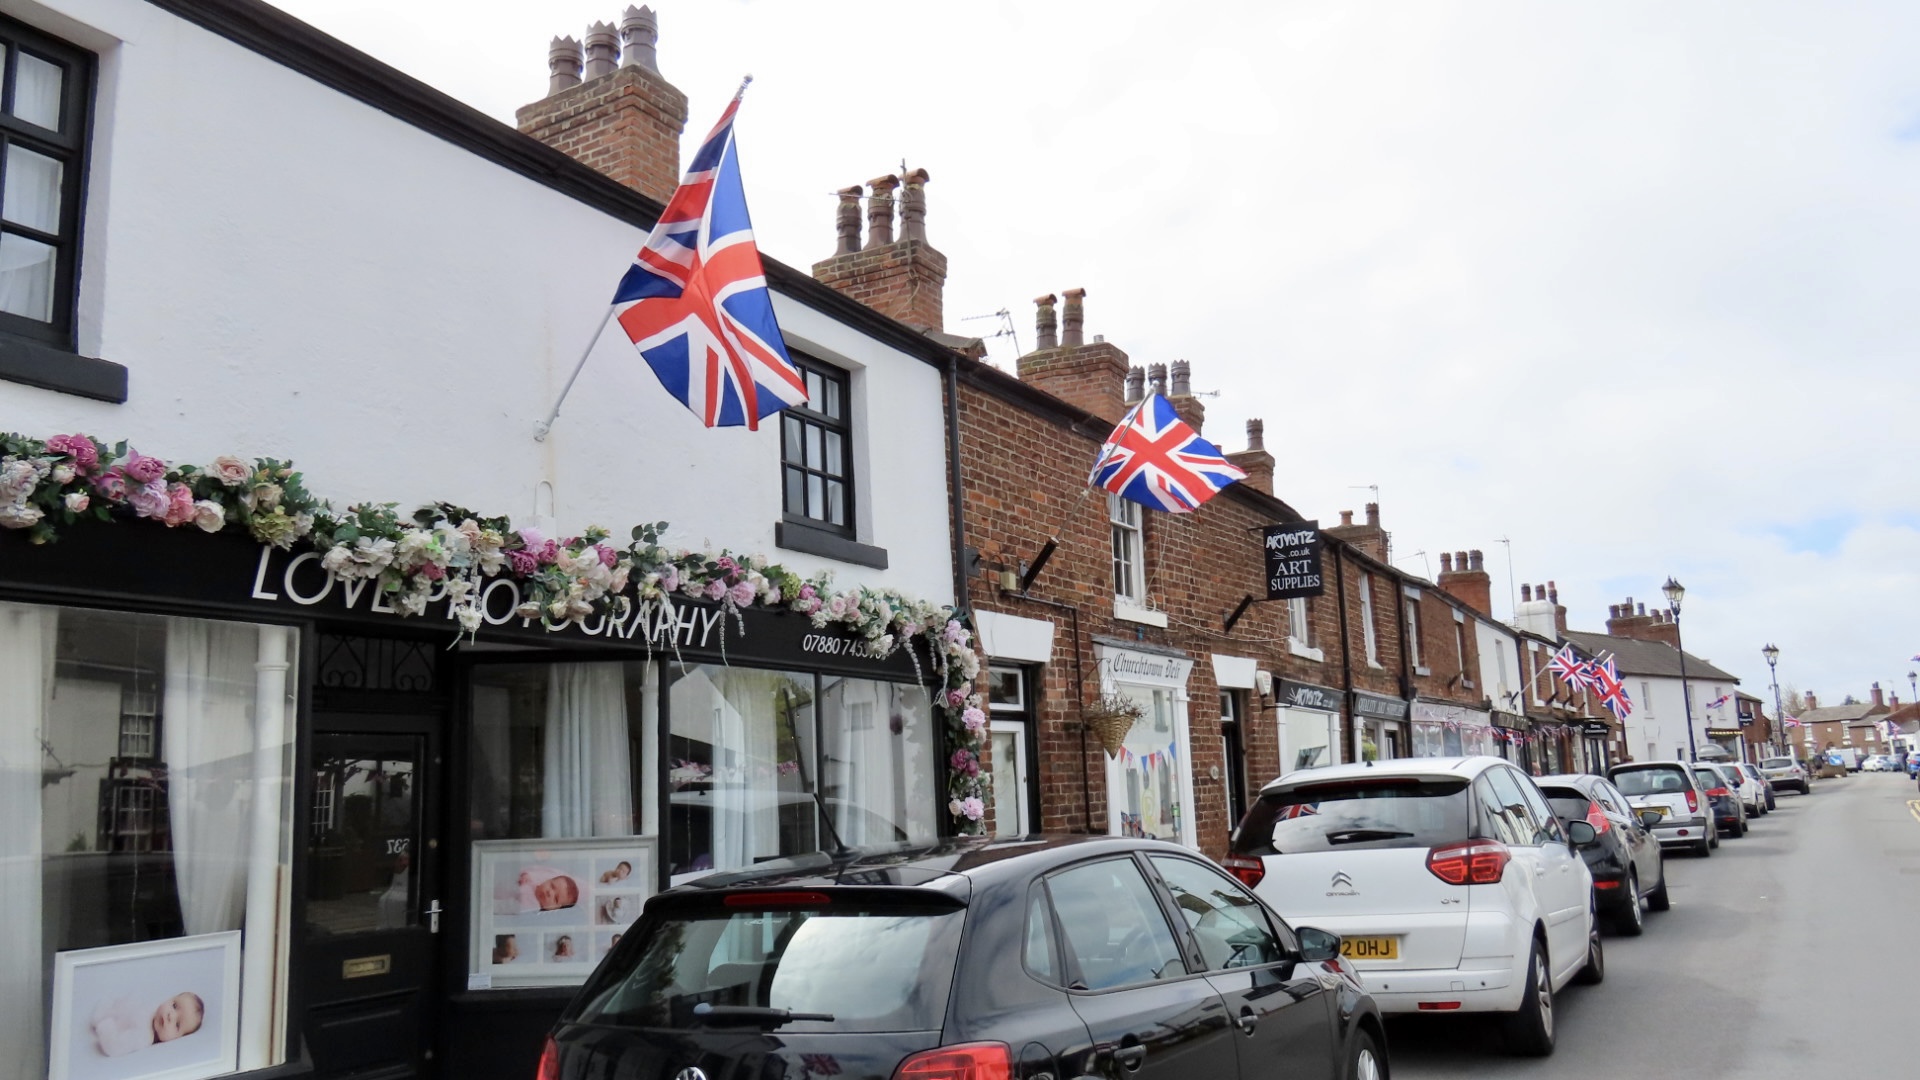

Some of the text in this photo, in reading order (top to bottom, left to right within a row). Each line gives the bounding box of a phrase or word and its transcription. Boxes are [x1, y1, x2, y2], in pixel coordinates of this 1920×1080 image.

[1275, 560, 1311, 576] ART
[1271, 575, 1320, 591] SUPPLIES
[803, 634, 882, 659] 07880 745
[1356, 939, 1390, 956] OHJ
